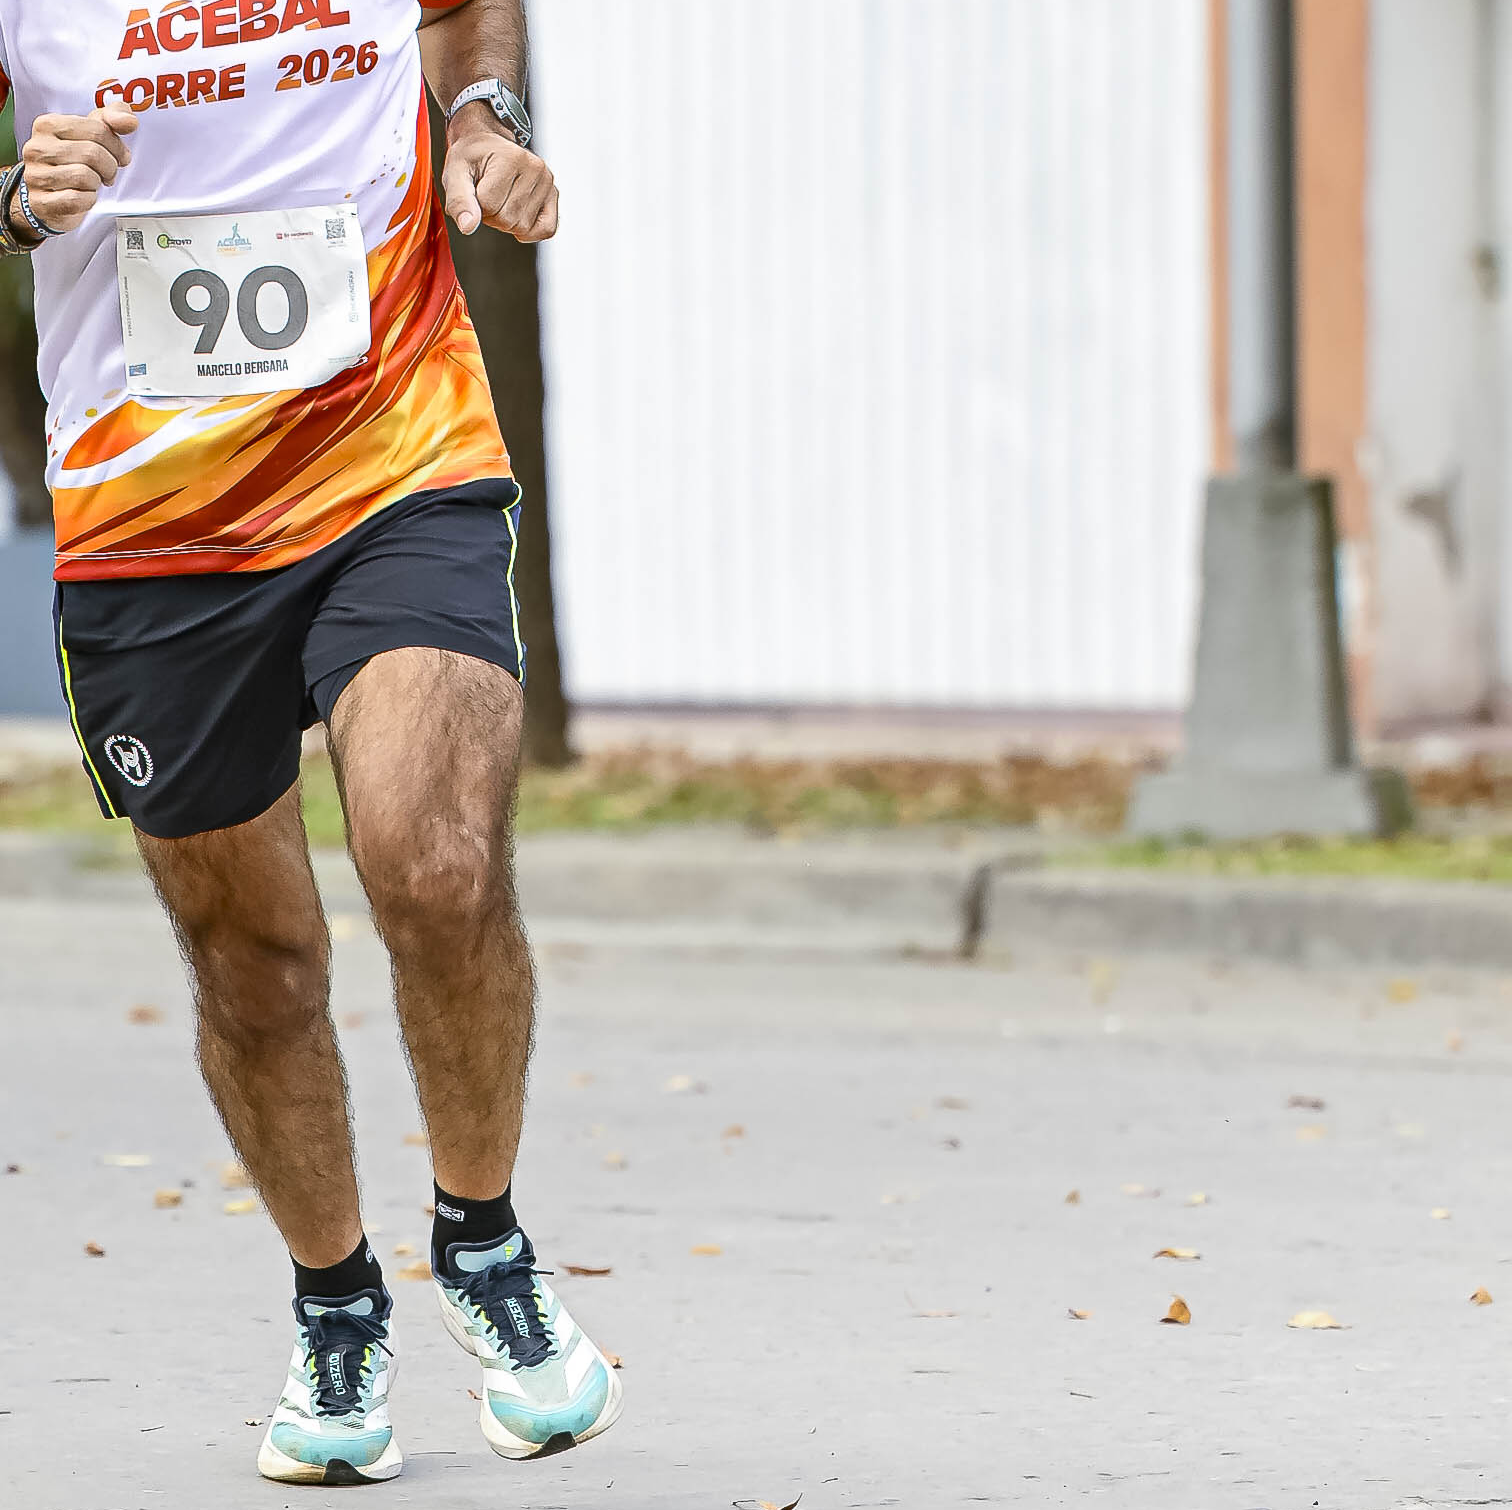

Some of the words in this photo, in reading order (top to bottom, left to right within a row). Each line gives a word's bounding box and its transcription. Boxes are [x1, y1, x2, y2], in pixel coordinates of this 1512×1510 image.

[94, 63, 246, 112] CORRE
[275, 40, 379, 92] 2026
[169, 265, 308, 354] 90
[197, 363, 241, 376] MARCELO
[244, 359, 289, 374] BERGARA
